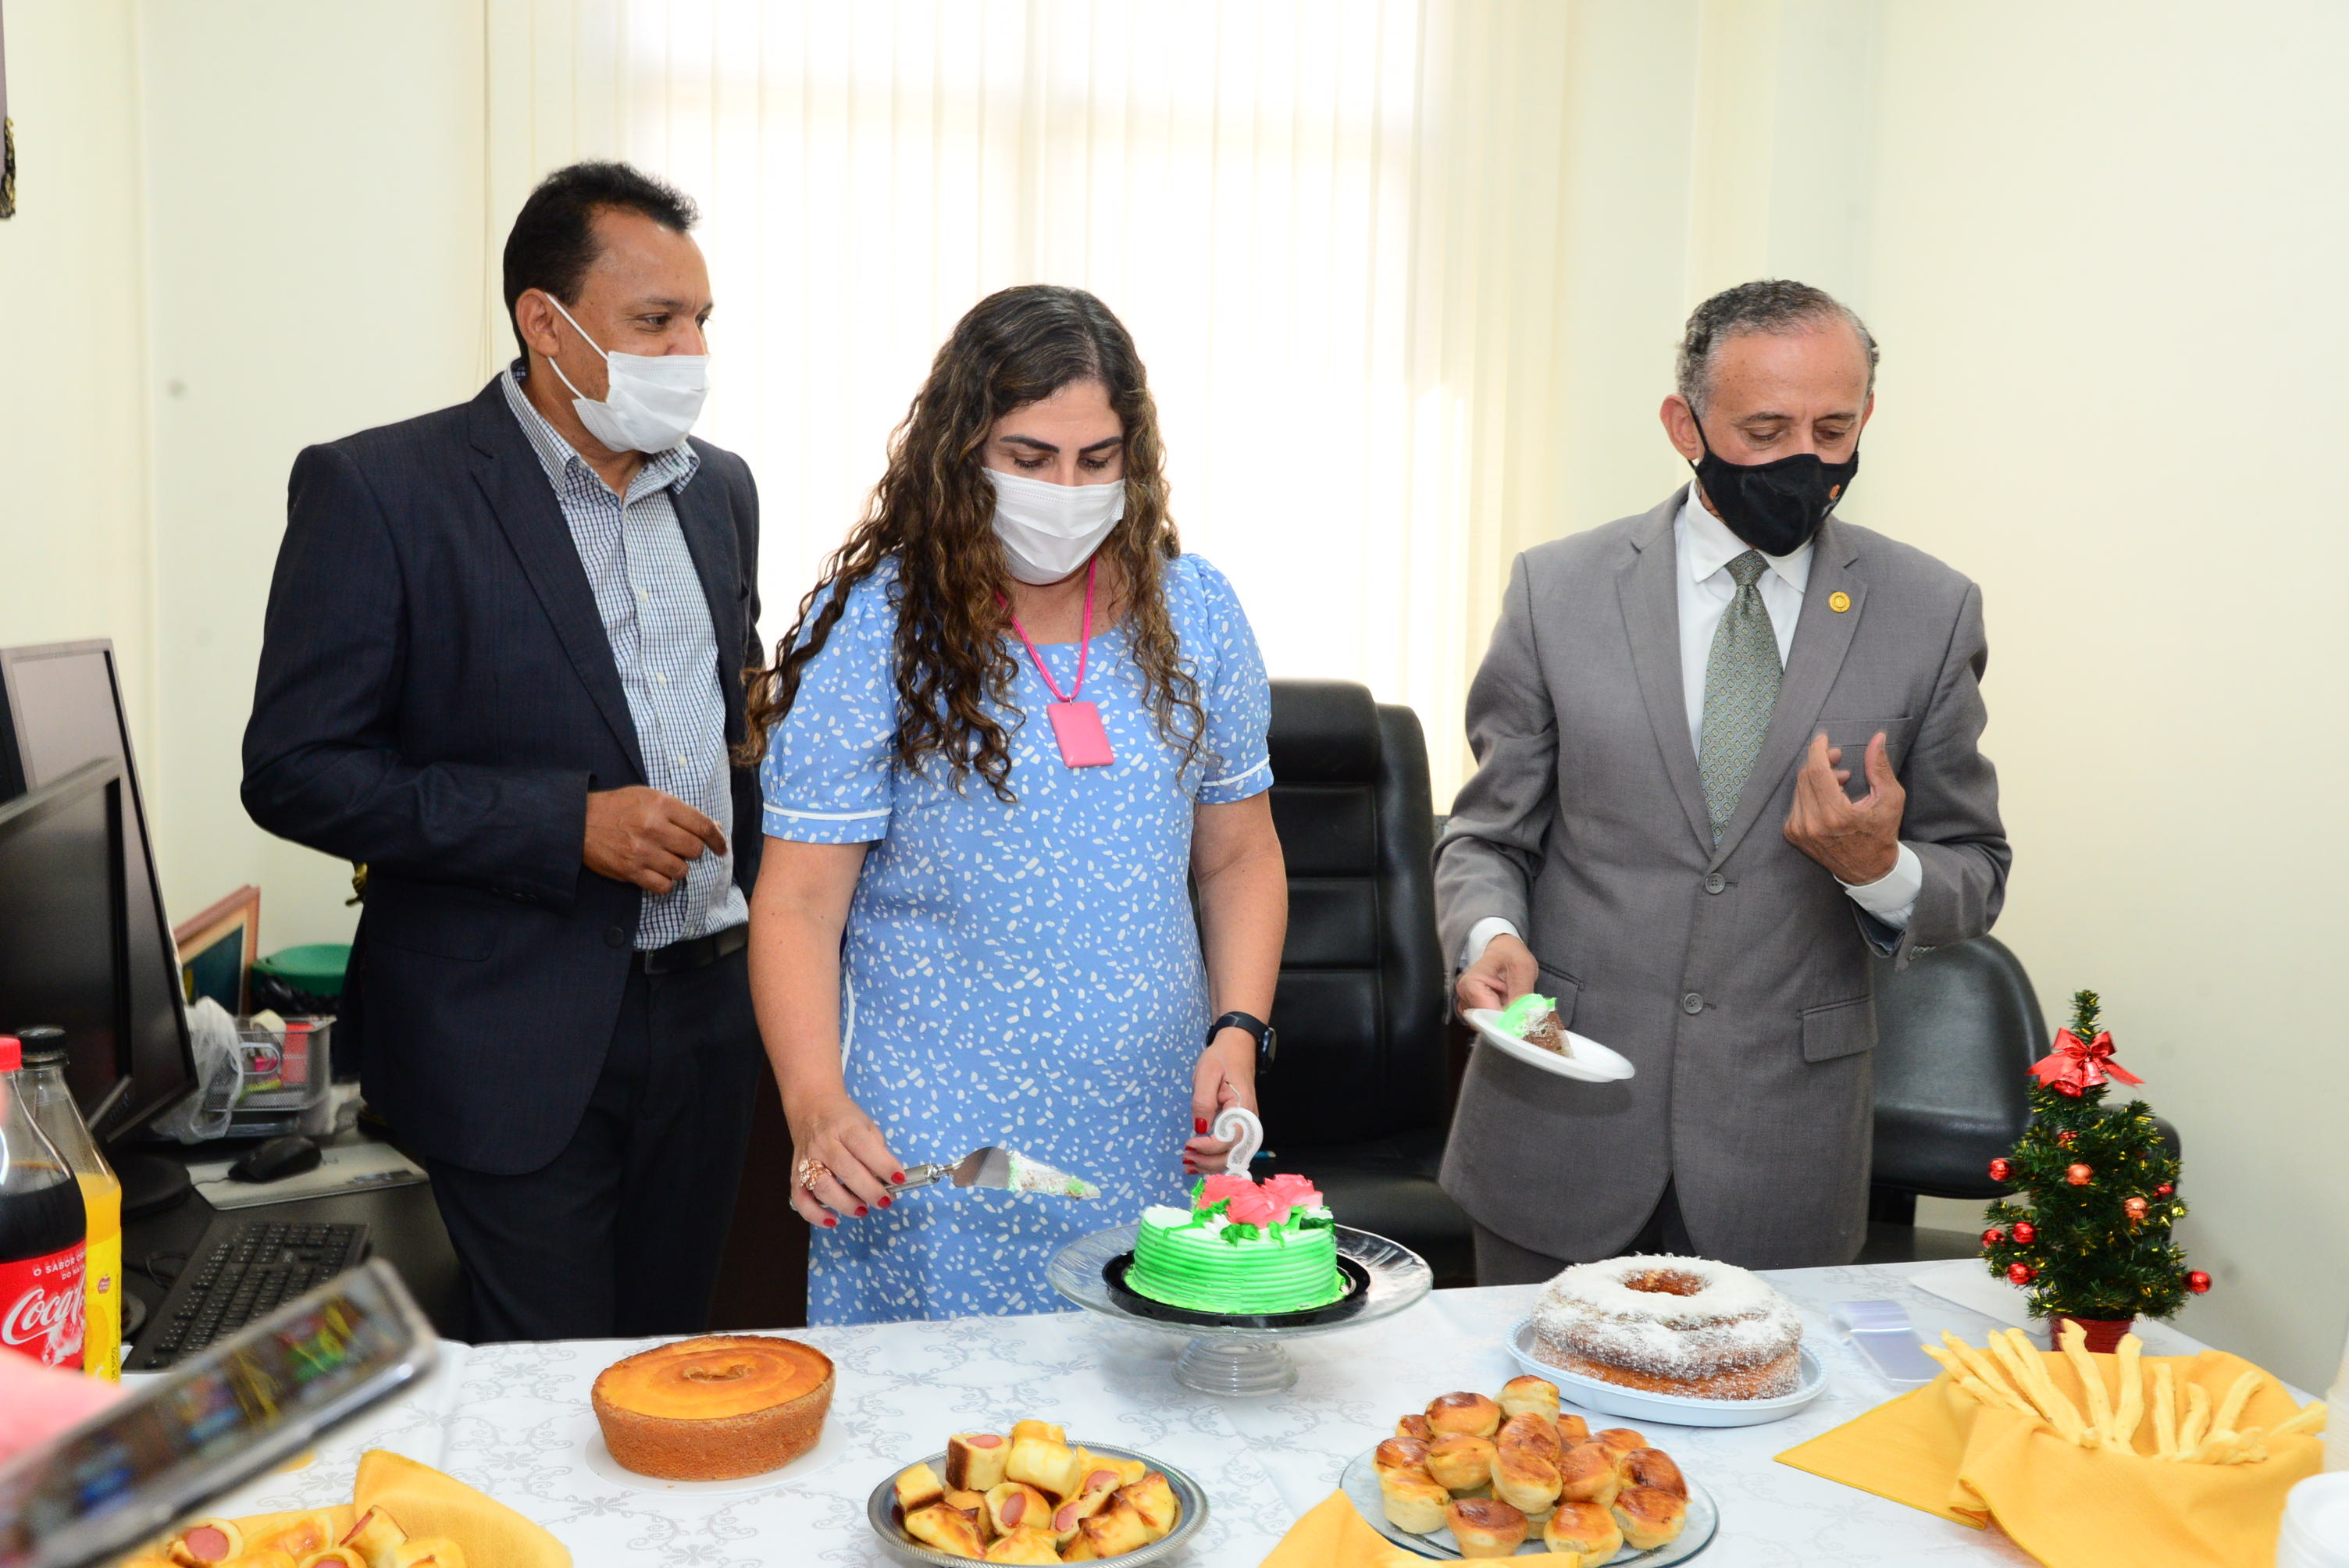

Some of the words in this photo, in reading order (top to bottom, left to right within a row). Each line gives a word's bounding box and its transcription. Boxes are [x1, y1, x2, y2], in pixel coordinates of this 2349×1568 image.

[34, 1267, 41, 1277] O
[45, 1256, 75, 1274] SABOR
[62, 1271, 72, 1281] DO
